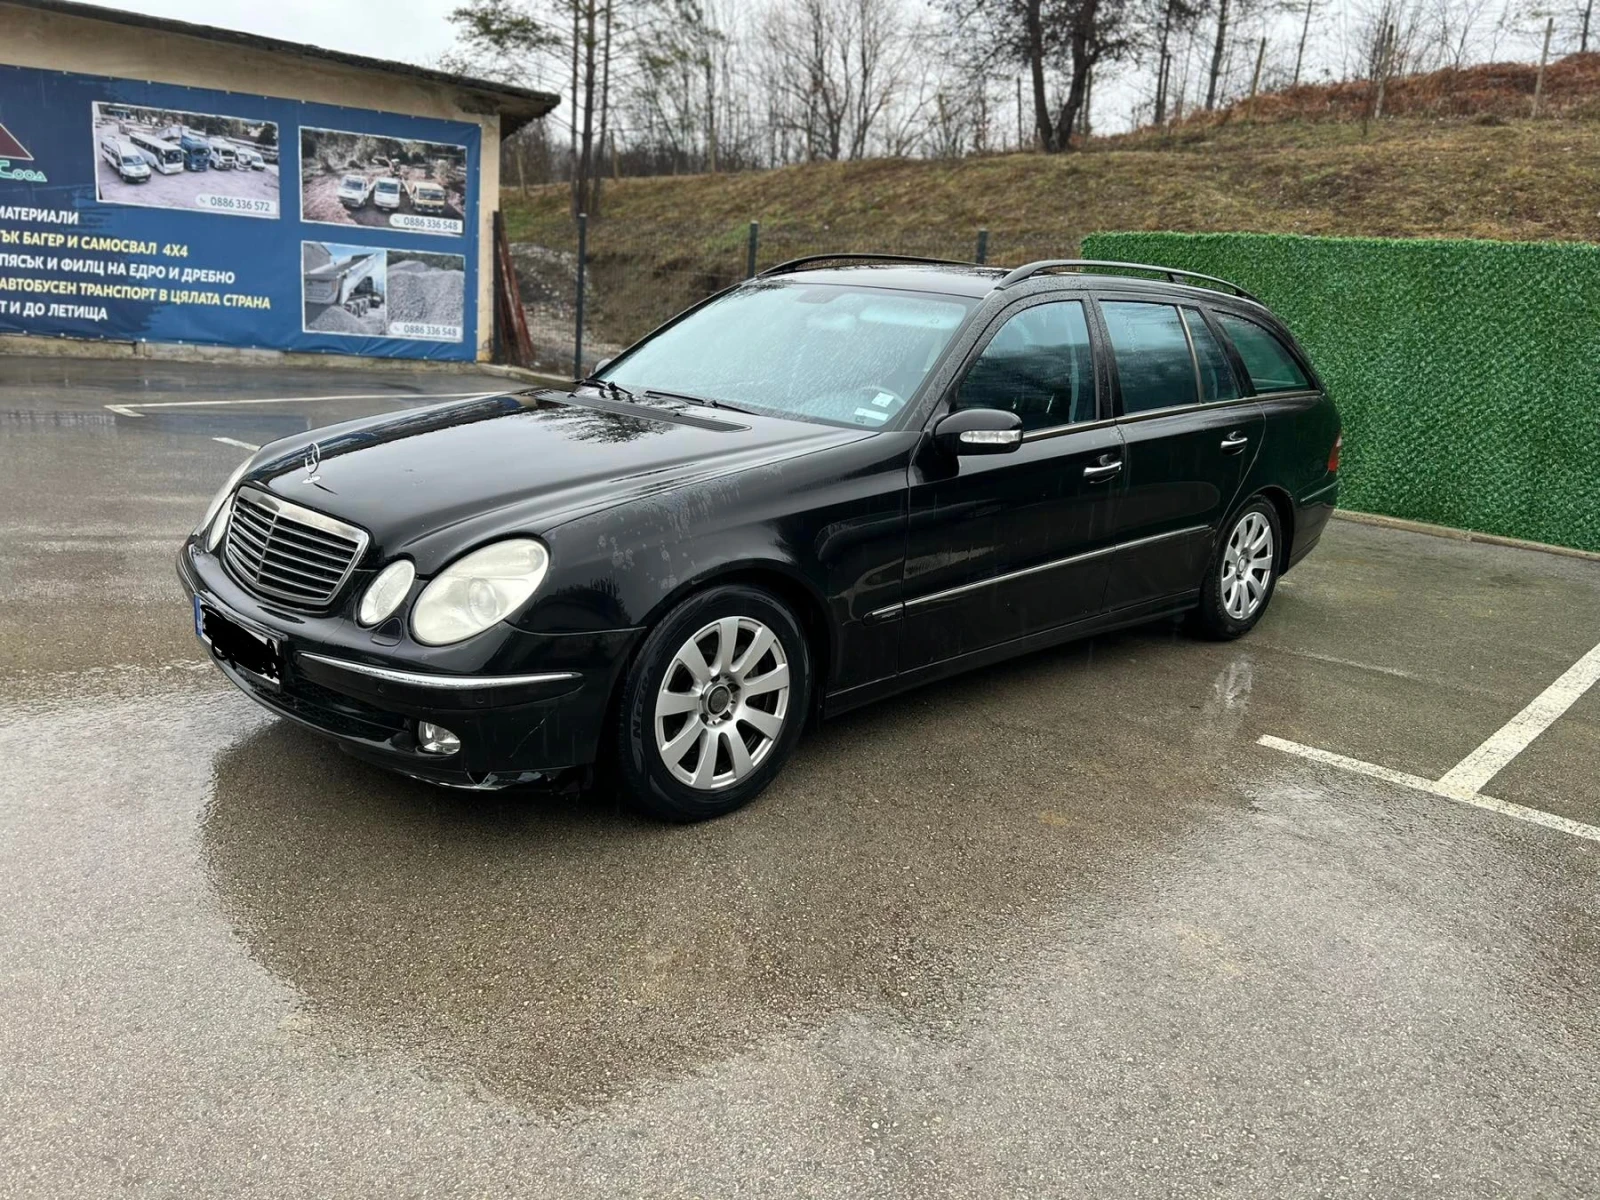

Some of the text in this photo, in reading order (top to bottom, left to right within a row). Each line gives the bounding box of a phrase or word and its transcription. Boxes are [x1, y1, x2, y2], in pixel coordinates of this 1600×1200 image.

[210, 196, 270, 212] 0886 336 572
[403, 216, 458, 231] 0886 336 548
[23, 231, 64, 247] БАГЕР
[67, 235, 78, 248] И
[81, 236, 157, 255] САМОСВАЛ
[0, 253, 235, 284] ПЯСЪК И ФИЛЦ НА ЕДРО И ДРЕБНО
[0, 277, 270, 309] АВТОБУСЕН ТРАНСПОРТ В ЦЯЛАТА СТРАНА
[9, 301, 20, 315] И
[23, 302, 45, 317] ДО
[48, 303, 108, 321] ЛЕТИЩА
[403, 324, 457, 337] 0886 336 548
